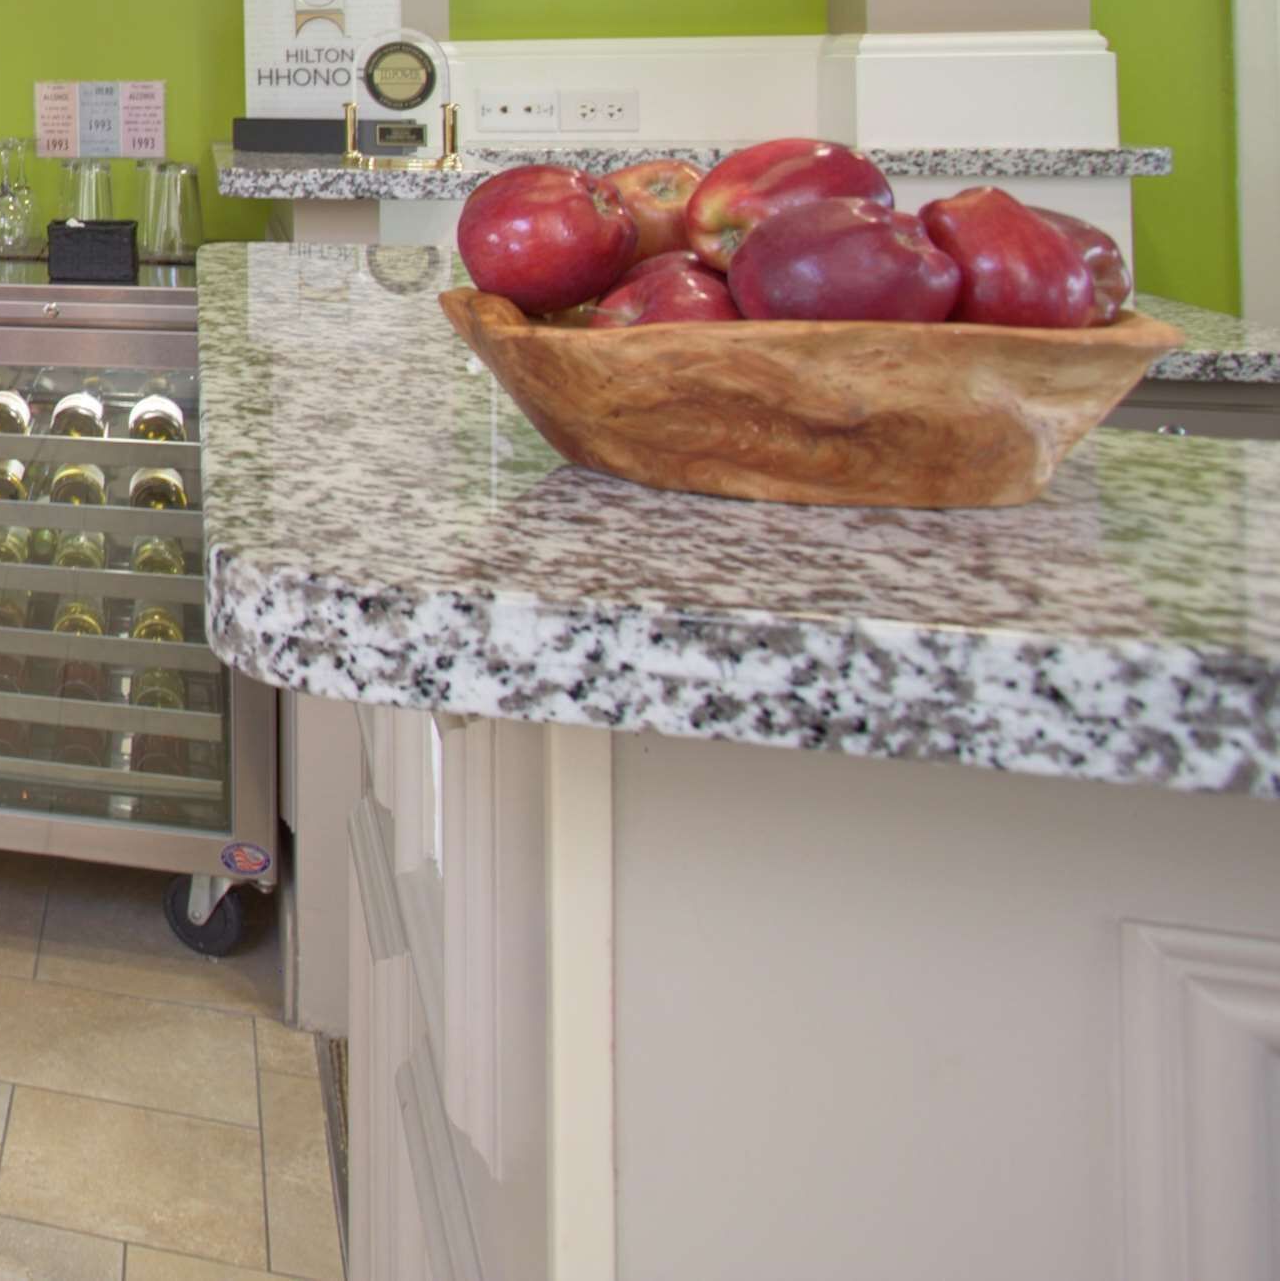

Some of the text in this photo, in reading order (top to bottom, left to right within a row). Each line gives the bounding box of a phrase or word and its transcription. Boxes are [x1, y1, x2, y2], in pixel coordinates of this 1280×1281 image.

[286, 48, 354, 64] HILTON
[89, 120, 112, 131] 1993
[46, 138, 69, 151] 1993
[131, 137, 156, 150] 1993
